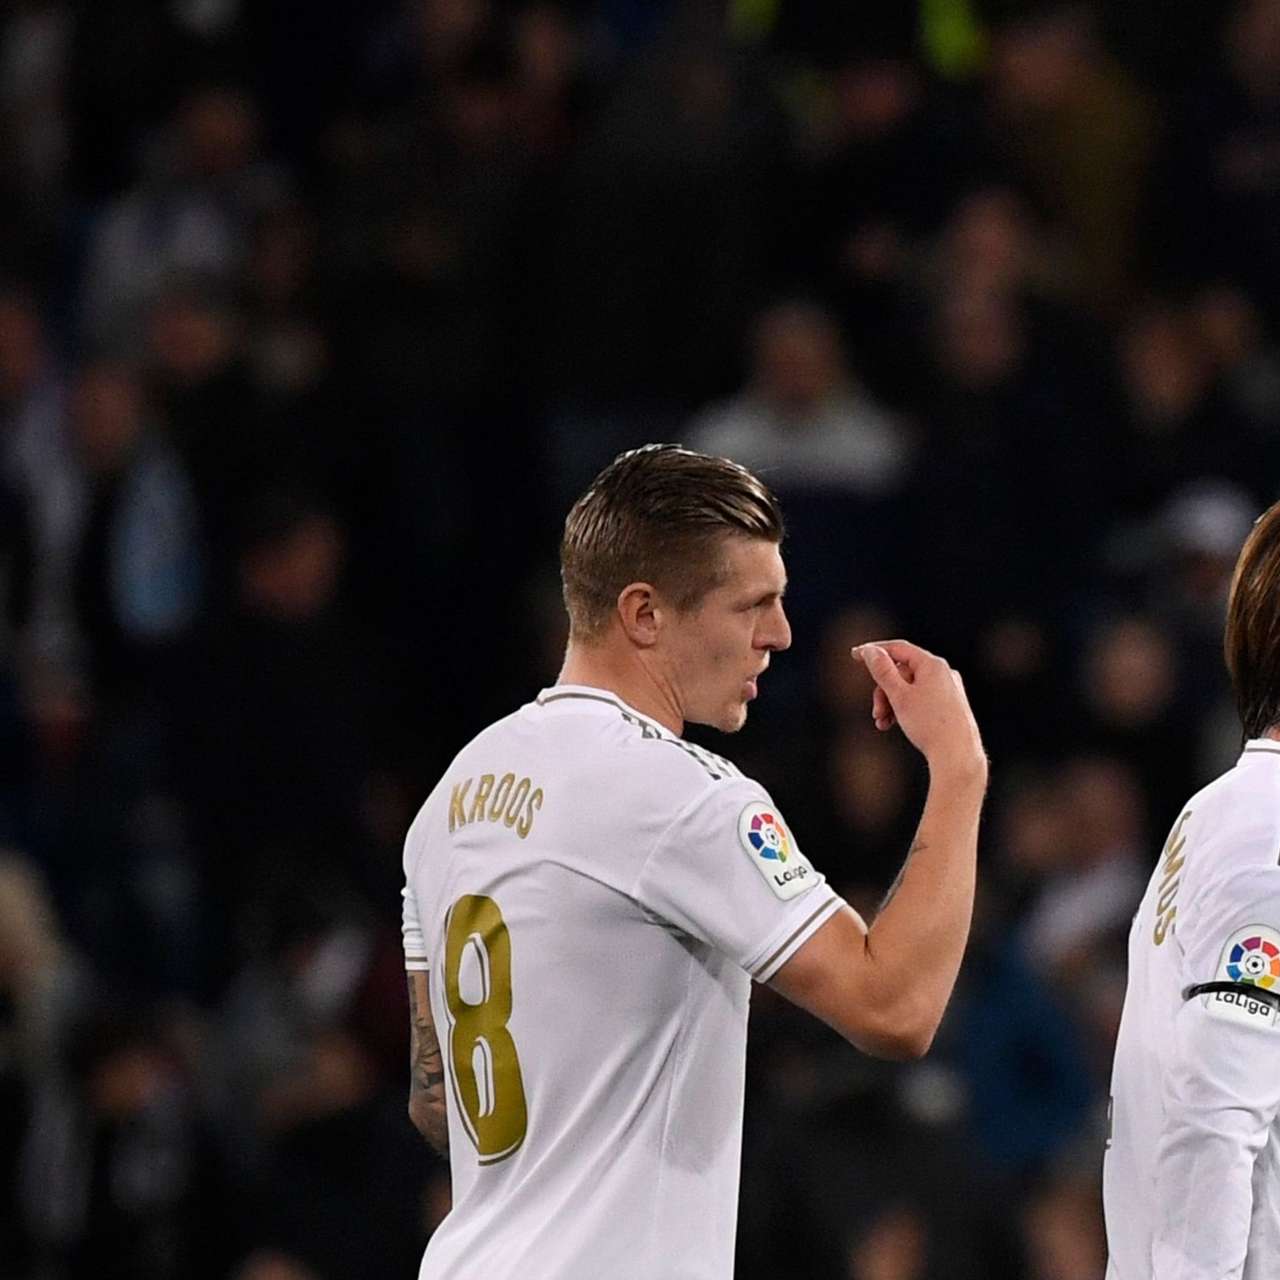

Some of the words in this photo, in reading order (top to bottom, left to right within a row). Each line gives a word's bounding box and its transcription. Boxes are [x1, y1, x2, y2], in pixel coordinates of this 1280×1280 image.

[448, 773, 543, 839] KROOS
[443, 894, 529, 1167] 8
[1215, 991, 1271, 1016] LaLiga
